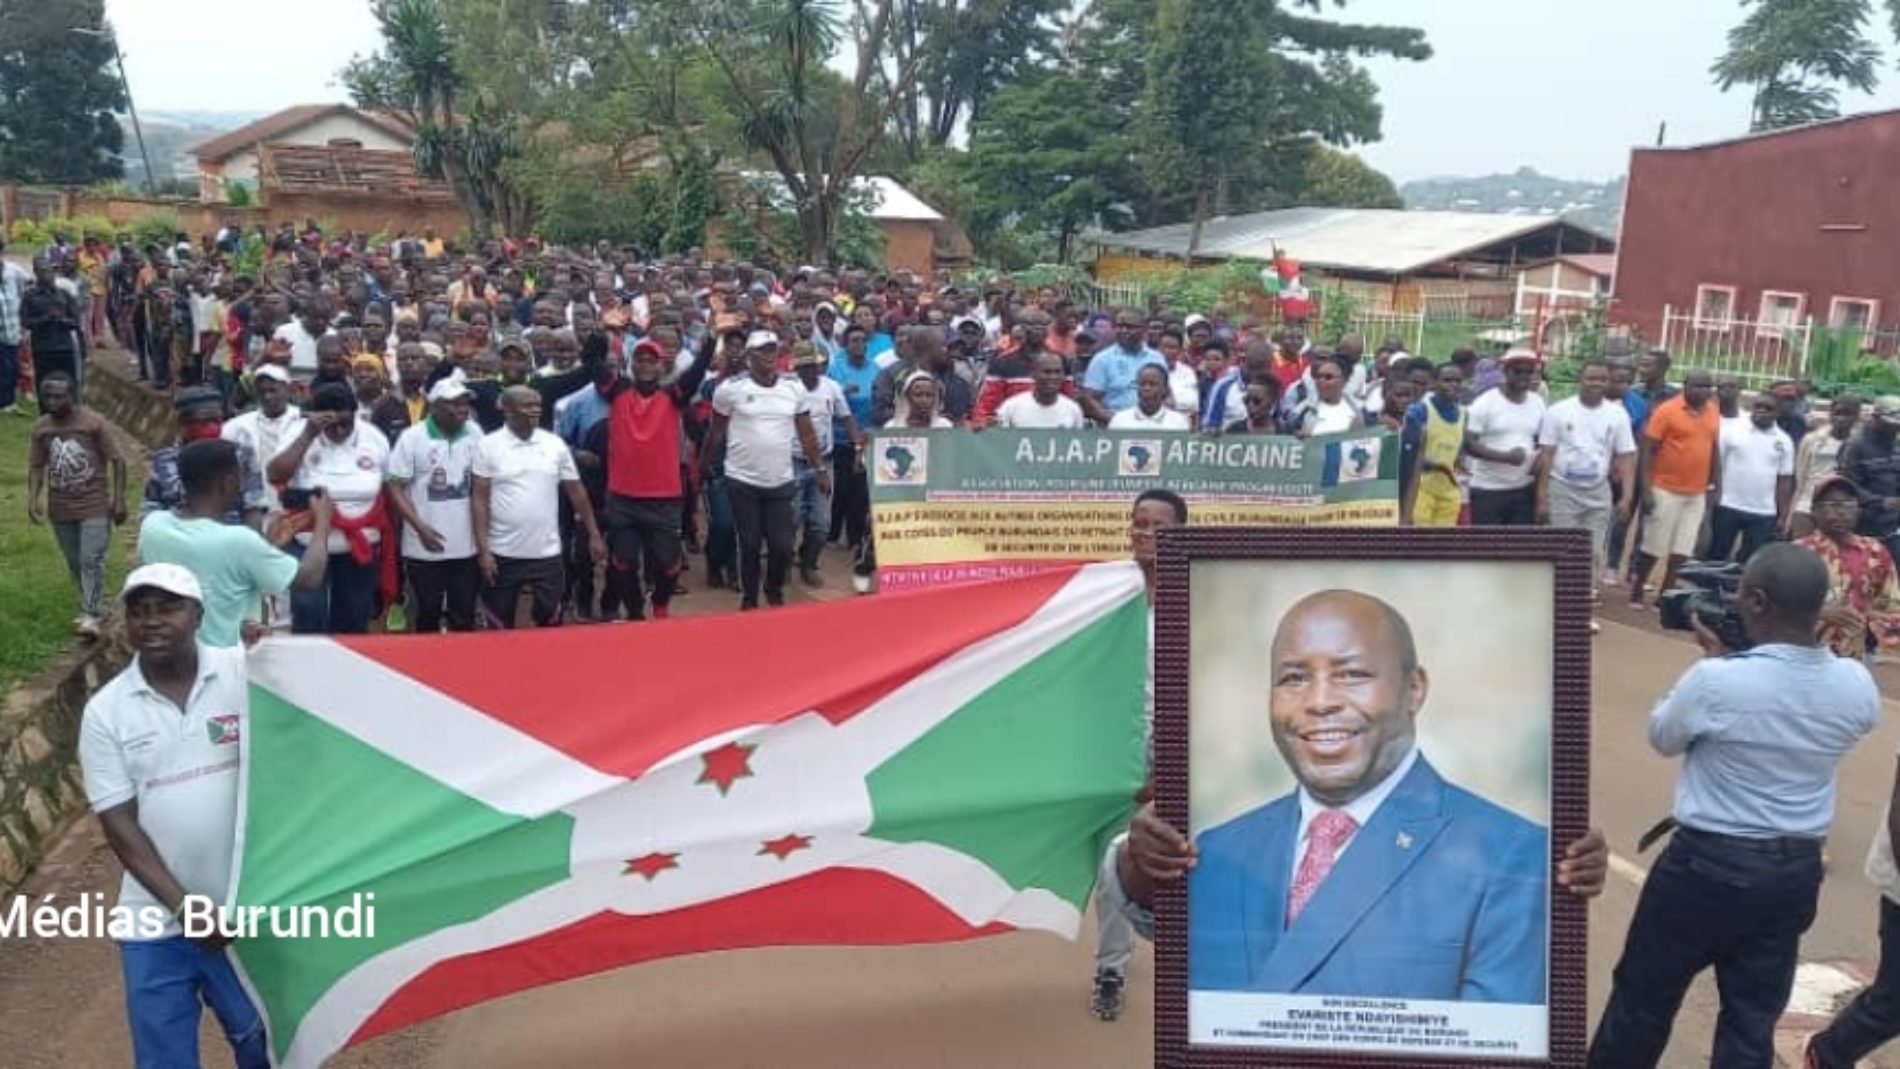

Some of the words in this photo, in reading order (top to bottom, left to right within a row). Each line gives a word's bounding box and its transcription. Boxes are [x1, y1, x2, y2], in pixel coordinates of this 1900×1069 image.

[1015, 437, 1112, 463] A.J.A.P
[1167, 440, 1303, 469] AFRICAINE
[1038, 511, 1122, 520] ORGANISATIONS
[1288, 1009, 1352, 1021] EVARISTE
